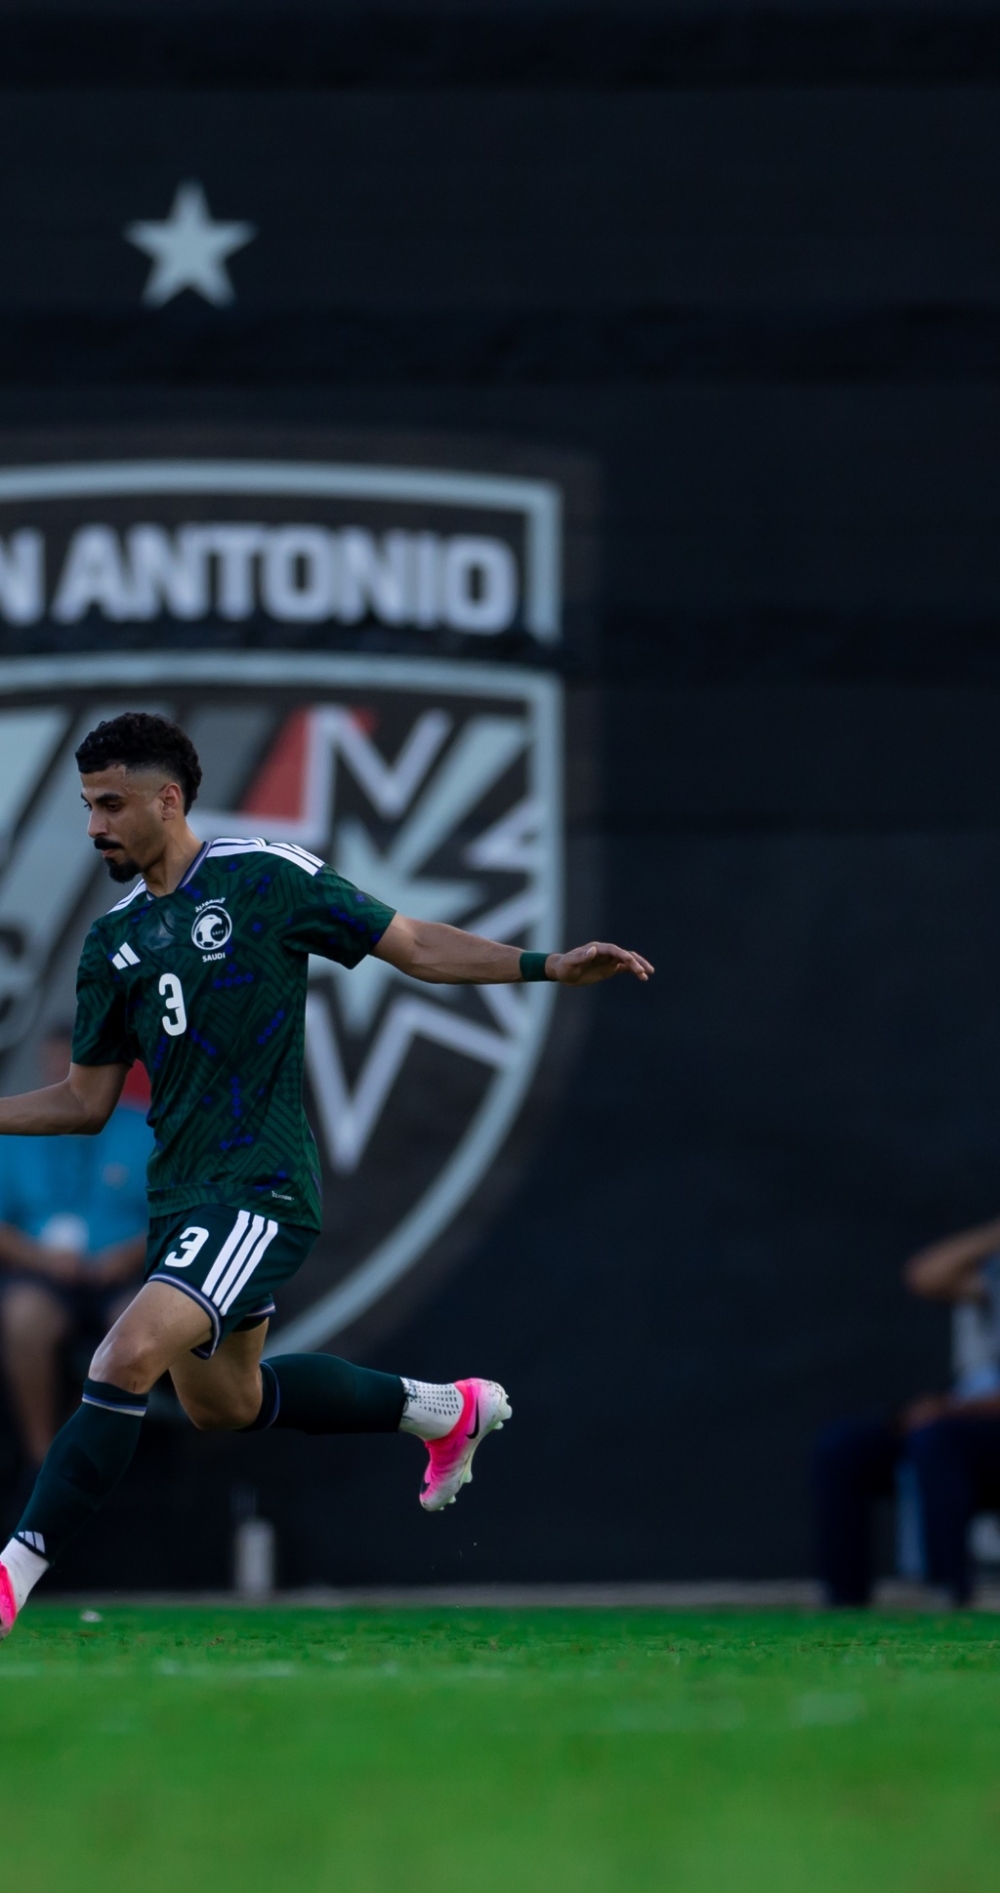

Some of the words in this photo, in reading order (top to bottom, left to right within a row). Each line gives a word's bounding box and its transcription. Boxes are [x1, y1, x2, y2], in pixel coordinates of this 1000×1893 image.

[53, 522, 515, 634] ANTONIO
[202, 952, 225, 962] SAUDI
[158, 973, 187, 1036] 3
[164, 1226, 210, 1268] 3
